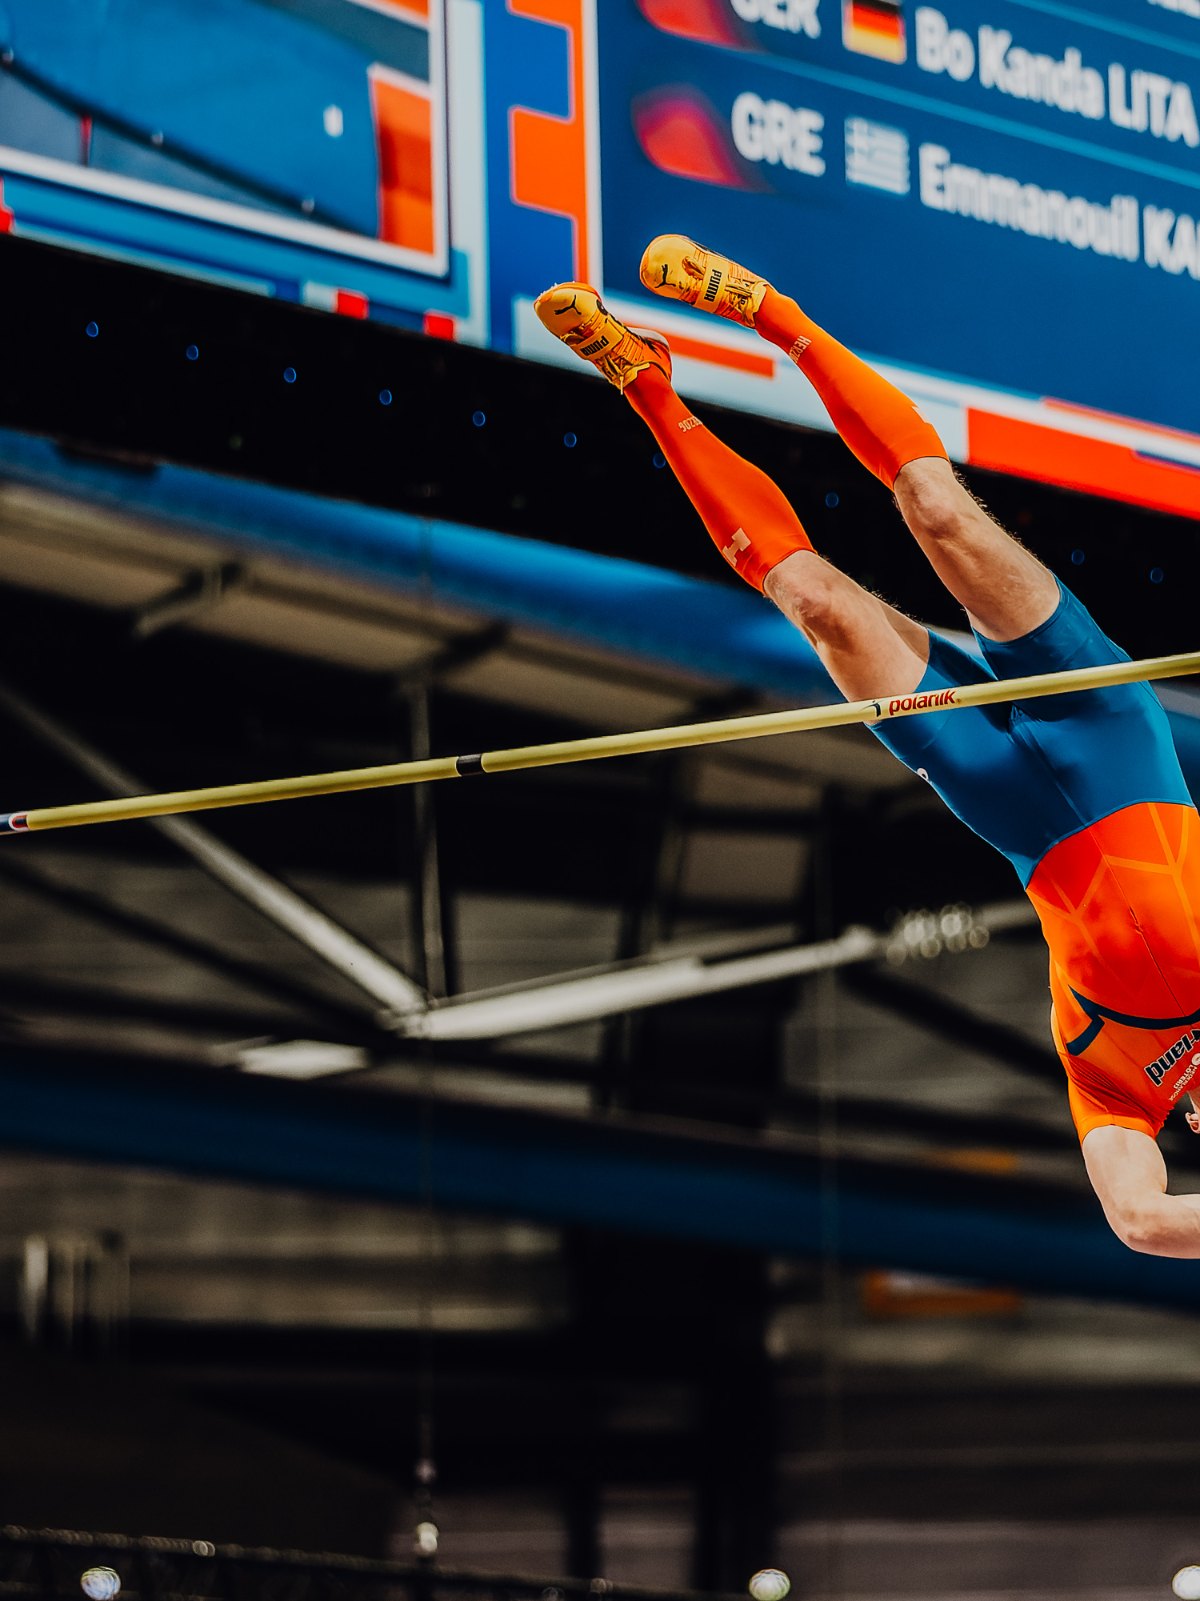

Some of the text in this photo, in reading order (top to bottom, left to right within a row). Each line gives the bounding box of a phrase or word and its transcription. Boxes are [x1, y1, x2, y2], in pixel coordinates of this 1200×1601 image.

[915, 7, 975, 81] Bo
[978, 25, 1105, 120] Kanda
[1108, 62, 1200, 147] LITA
[731, 93, 826, 176] GRE
[919, 143, 1139, 262] Emmanouil
[704, 268, 722, 303] PUMA
[580, 336, 609, 356] PUMA
